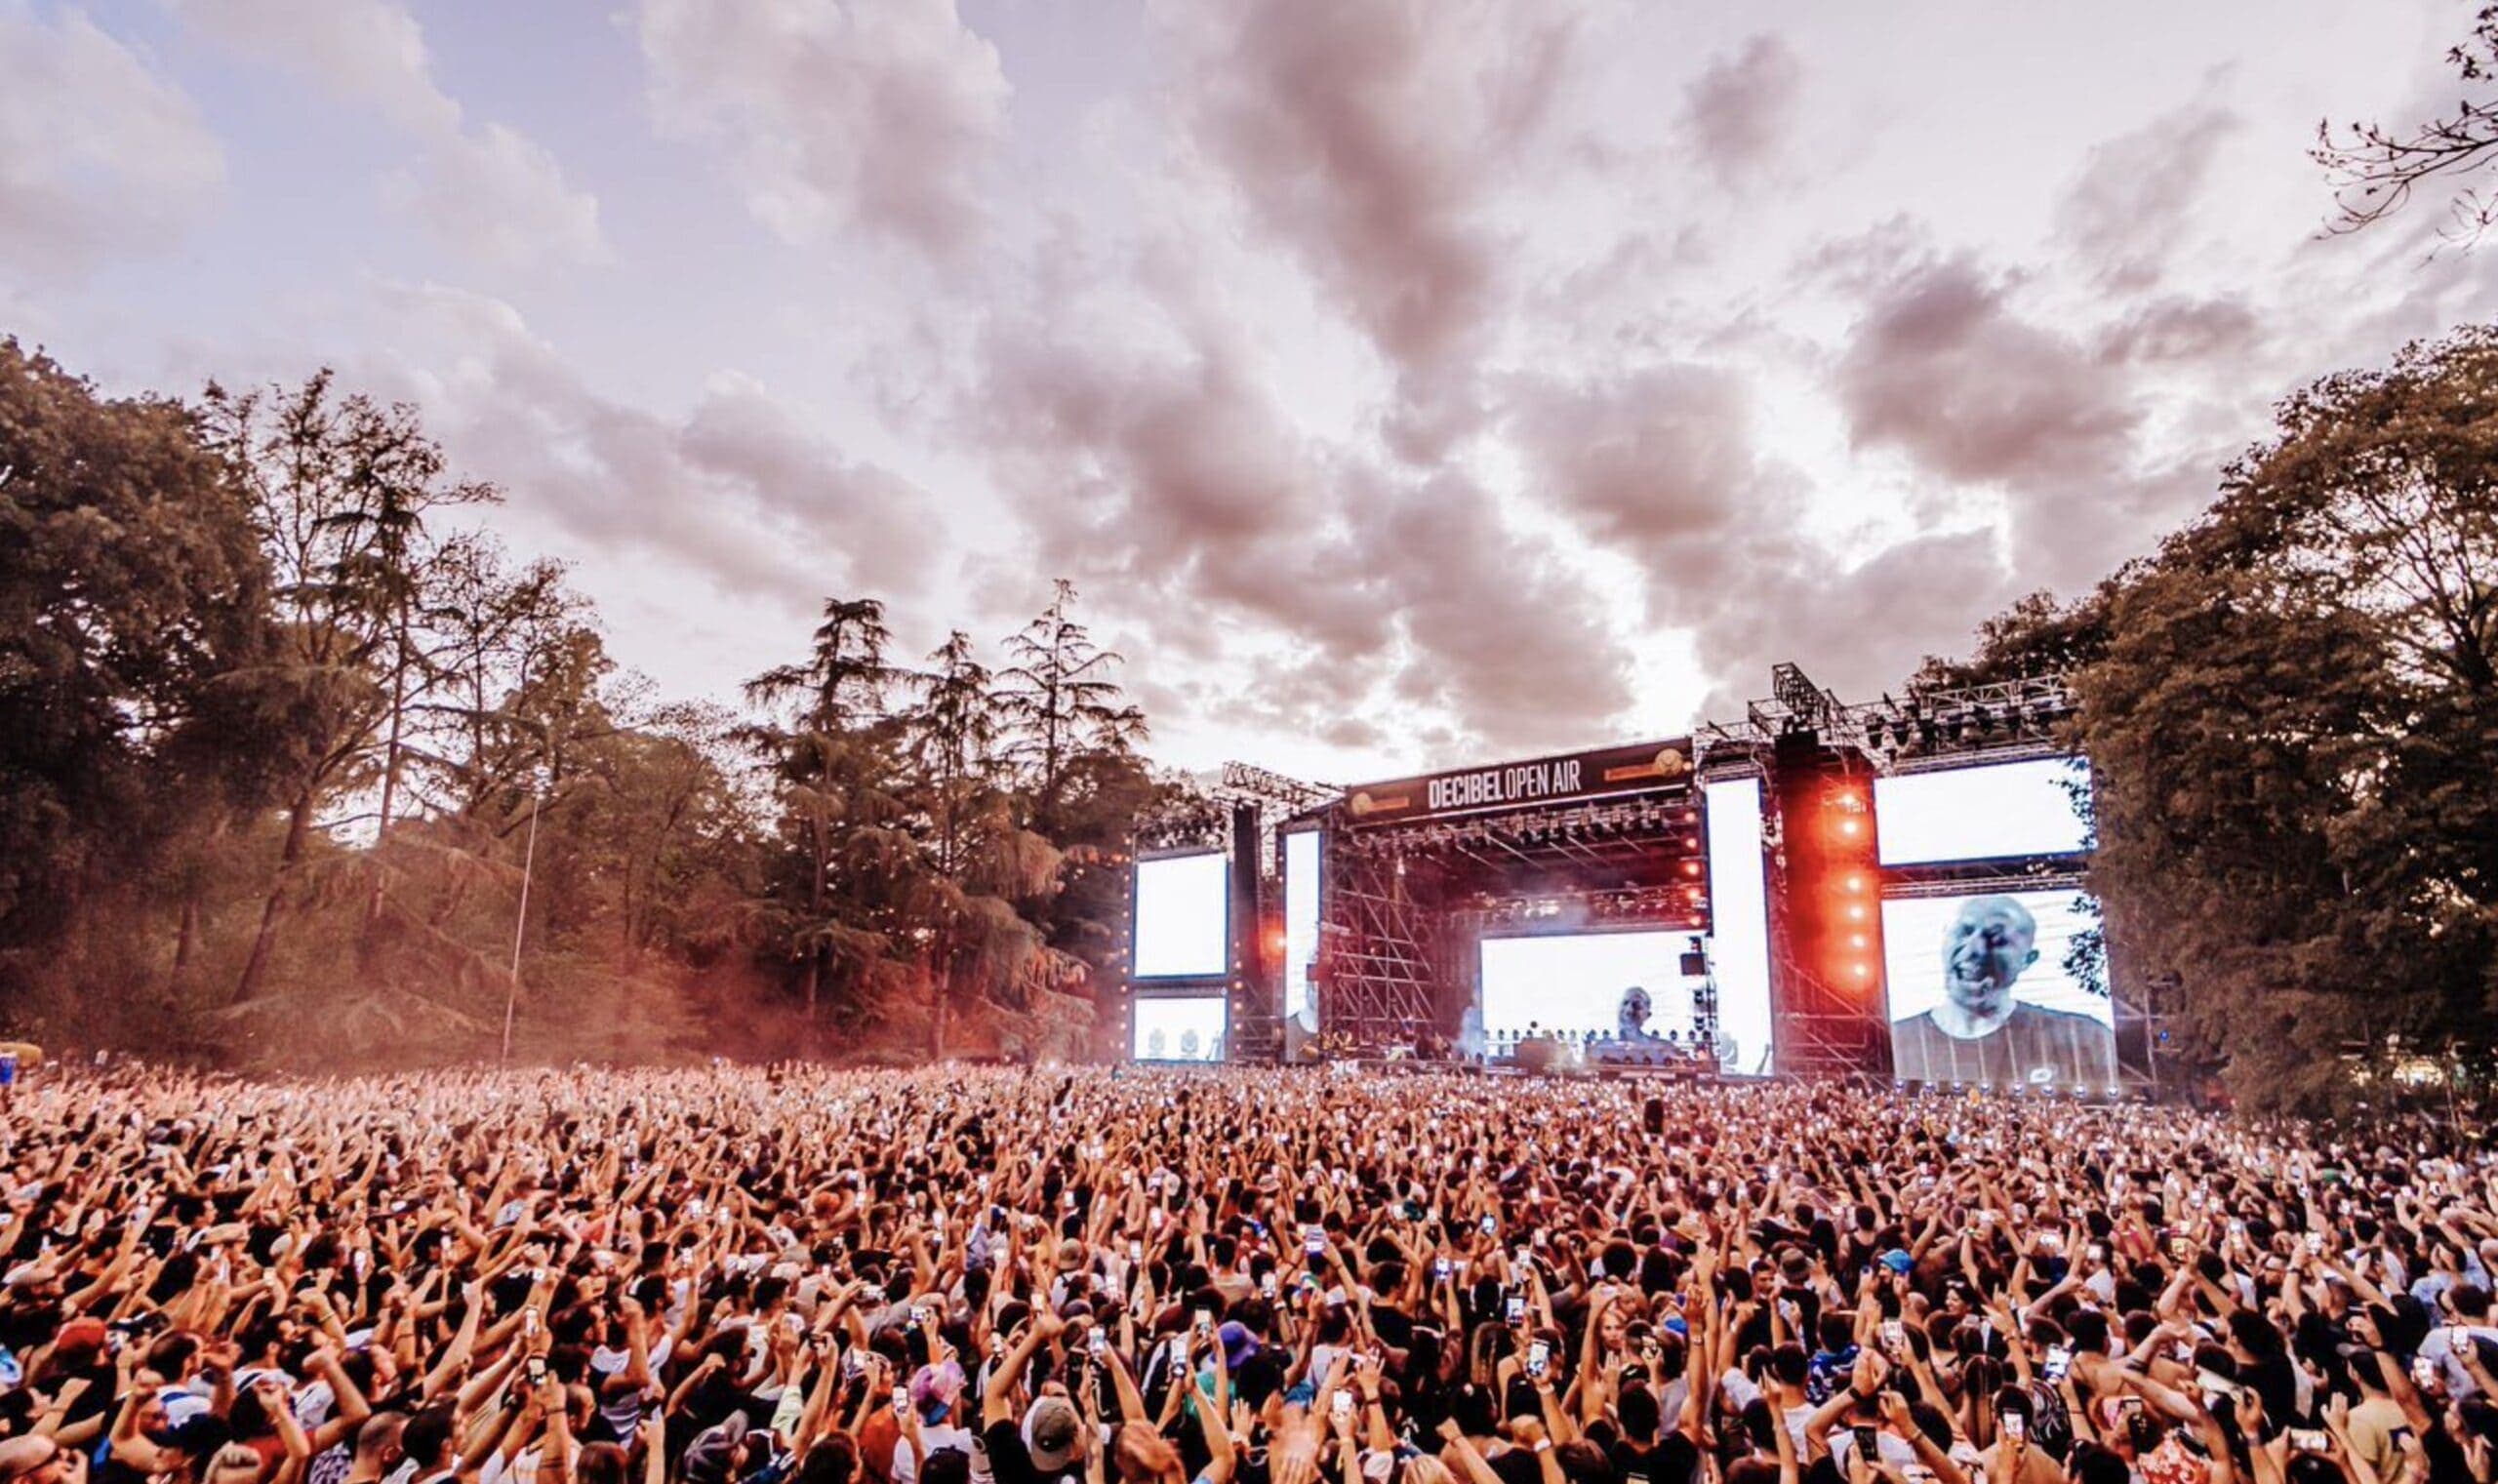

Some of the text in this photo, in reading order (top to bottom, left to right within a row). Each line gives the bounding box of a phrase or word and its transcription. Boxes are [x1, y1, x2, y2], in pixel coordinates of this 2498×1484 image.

[1429, 759, 1581, 810] DECIBEL OPEN AIR
